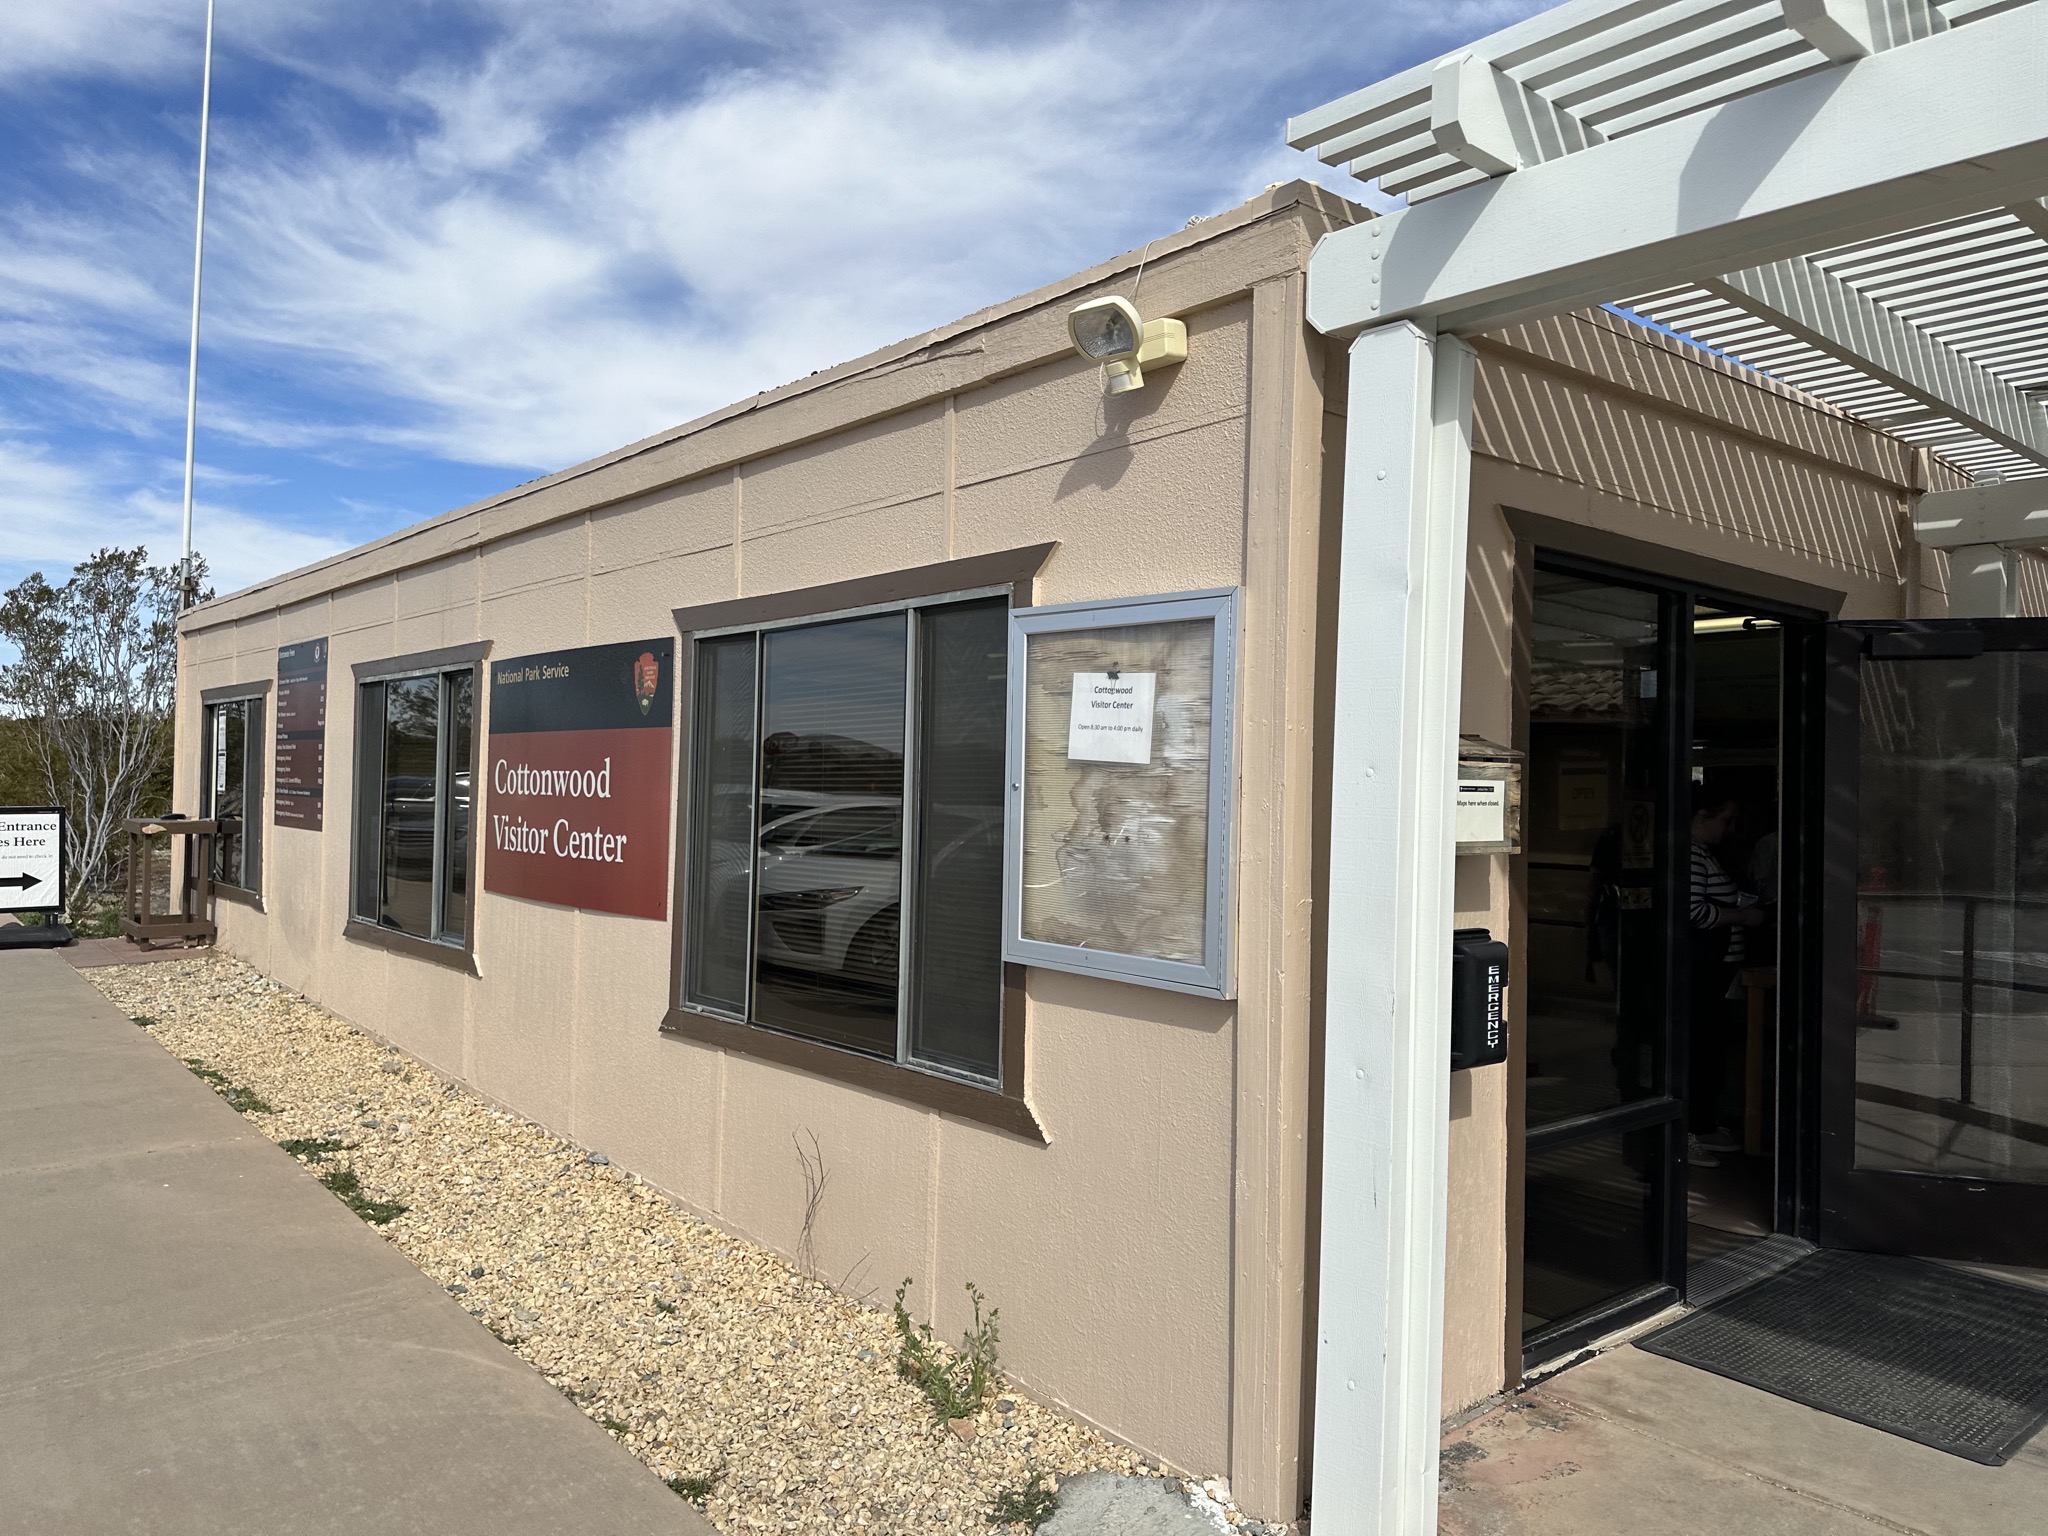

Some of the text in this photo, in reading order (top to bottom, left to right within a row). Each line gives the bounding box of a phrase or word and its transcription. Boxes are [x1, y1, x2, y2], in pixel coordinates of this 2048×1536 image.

[497, 662, 570, 685] National Park Service
[1091, 700, 1133, 709] Visitor Center
[1132, 725, 1143, 733] daily
[495, 757, 611, 798] Cottonwood
[13, 836, 46, 847] Here
[493, 815, 627, 863] Visitor Center
[1487, 965, 1499, 1048] EMERGENCY
